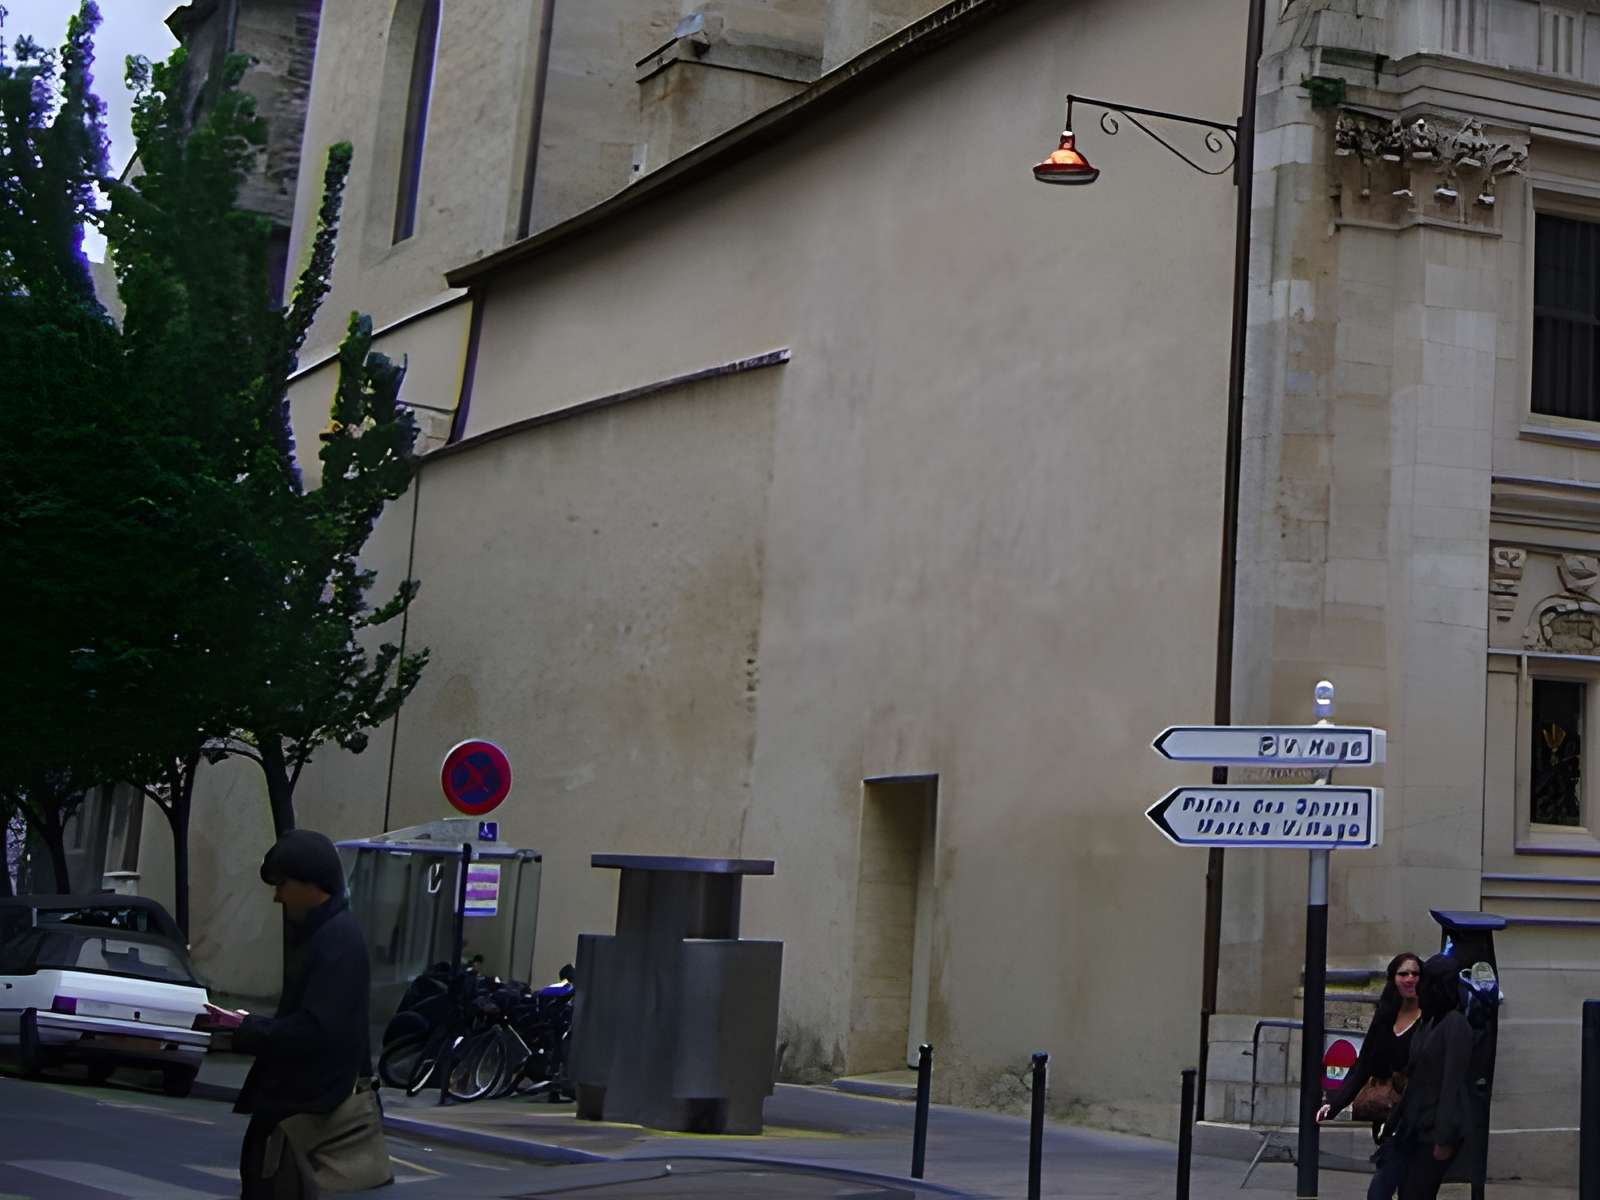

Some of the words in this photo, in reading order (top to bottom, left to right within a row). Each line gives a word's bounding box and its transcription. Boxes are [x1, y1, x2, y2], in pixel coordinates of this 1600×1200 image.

[1182, 797, 1241, 814] Palais
[1252, 799, 1285, 814] des
[1295, 798, 1360, 817] Sports
